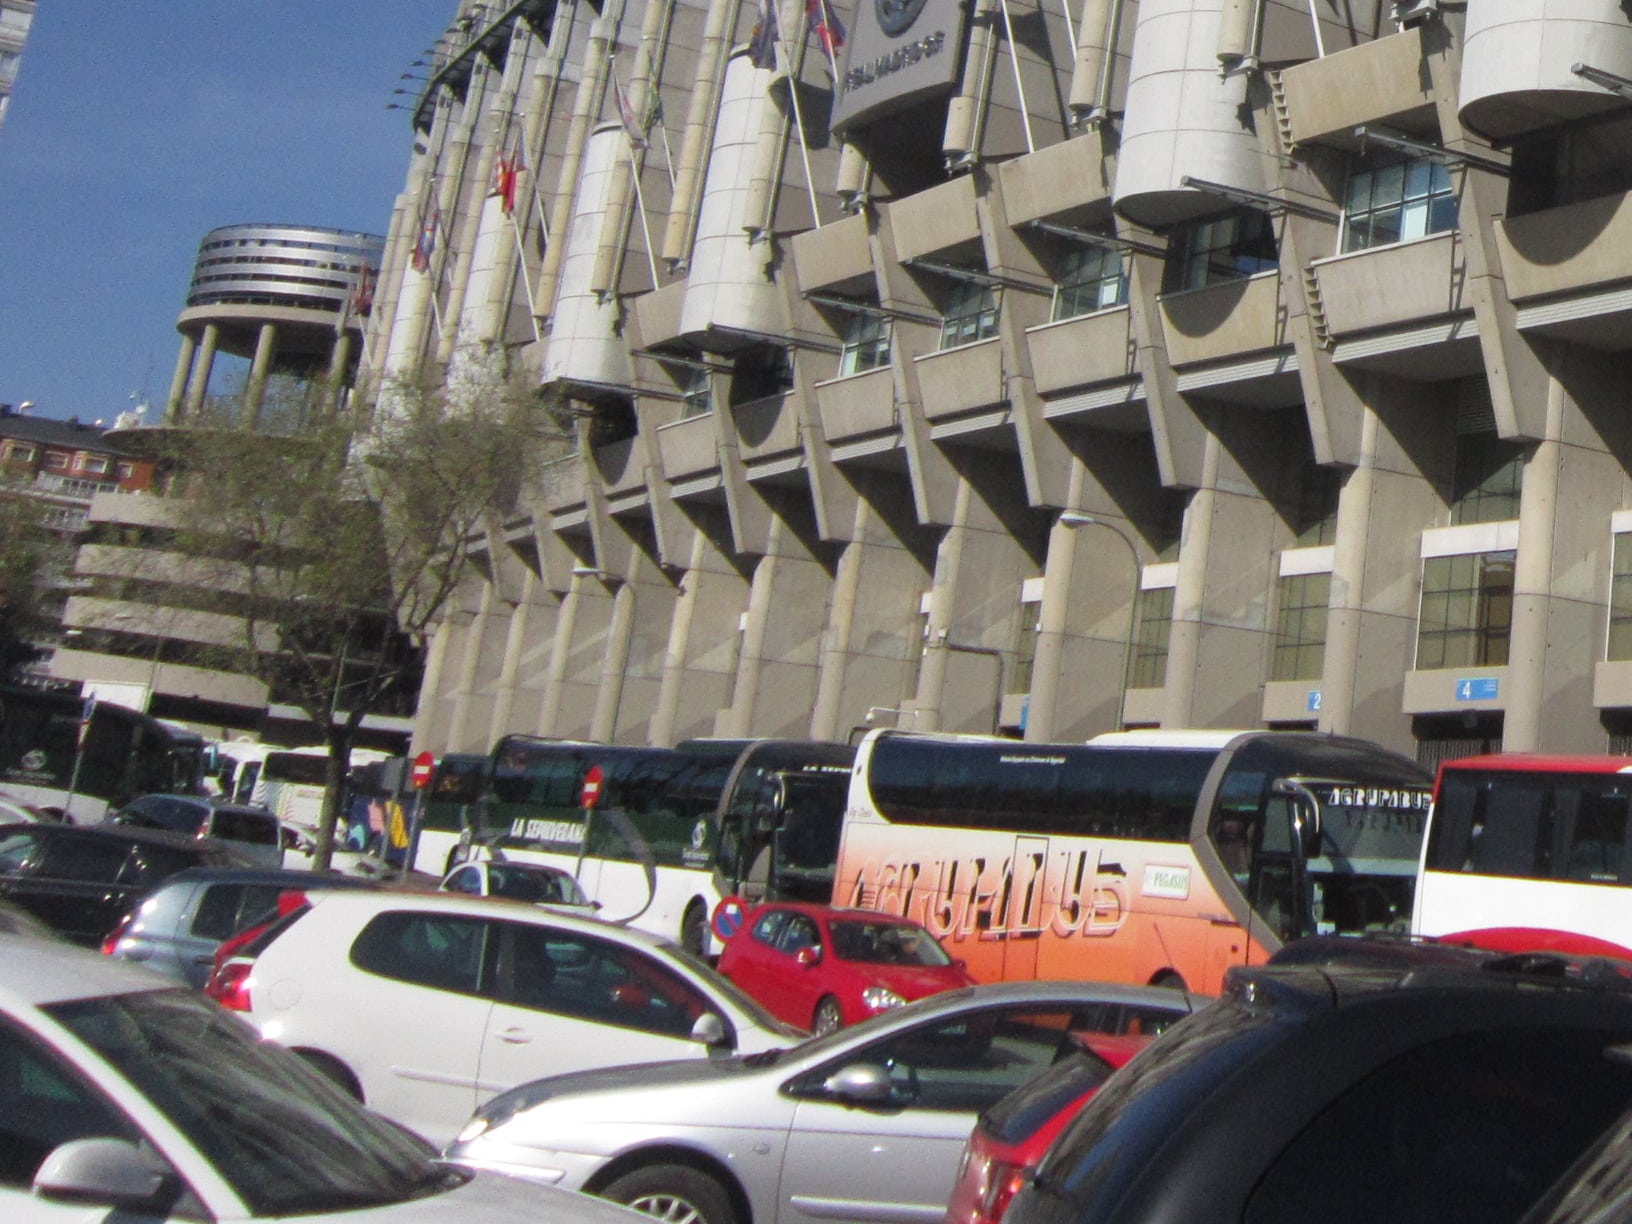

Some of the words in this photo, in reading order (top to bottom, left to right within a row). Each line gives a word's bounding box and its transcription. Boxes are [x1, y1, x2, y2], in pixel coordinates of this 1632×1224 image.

[1462, 681, 1472, 698] 4
[1312, 692, 1322, 710] 2
[1328, 786, 1433, 810] AGRUPABUS
[510, 817, 525, 838] LA
